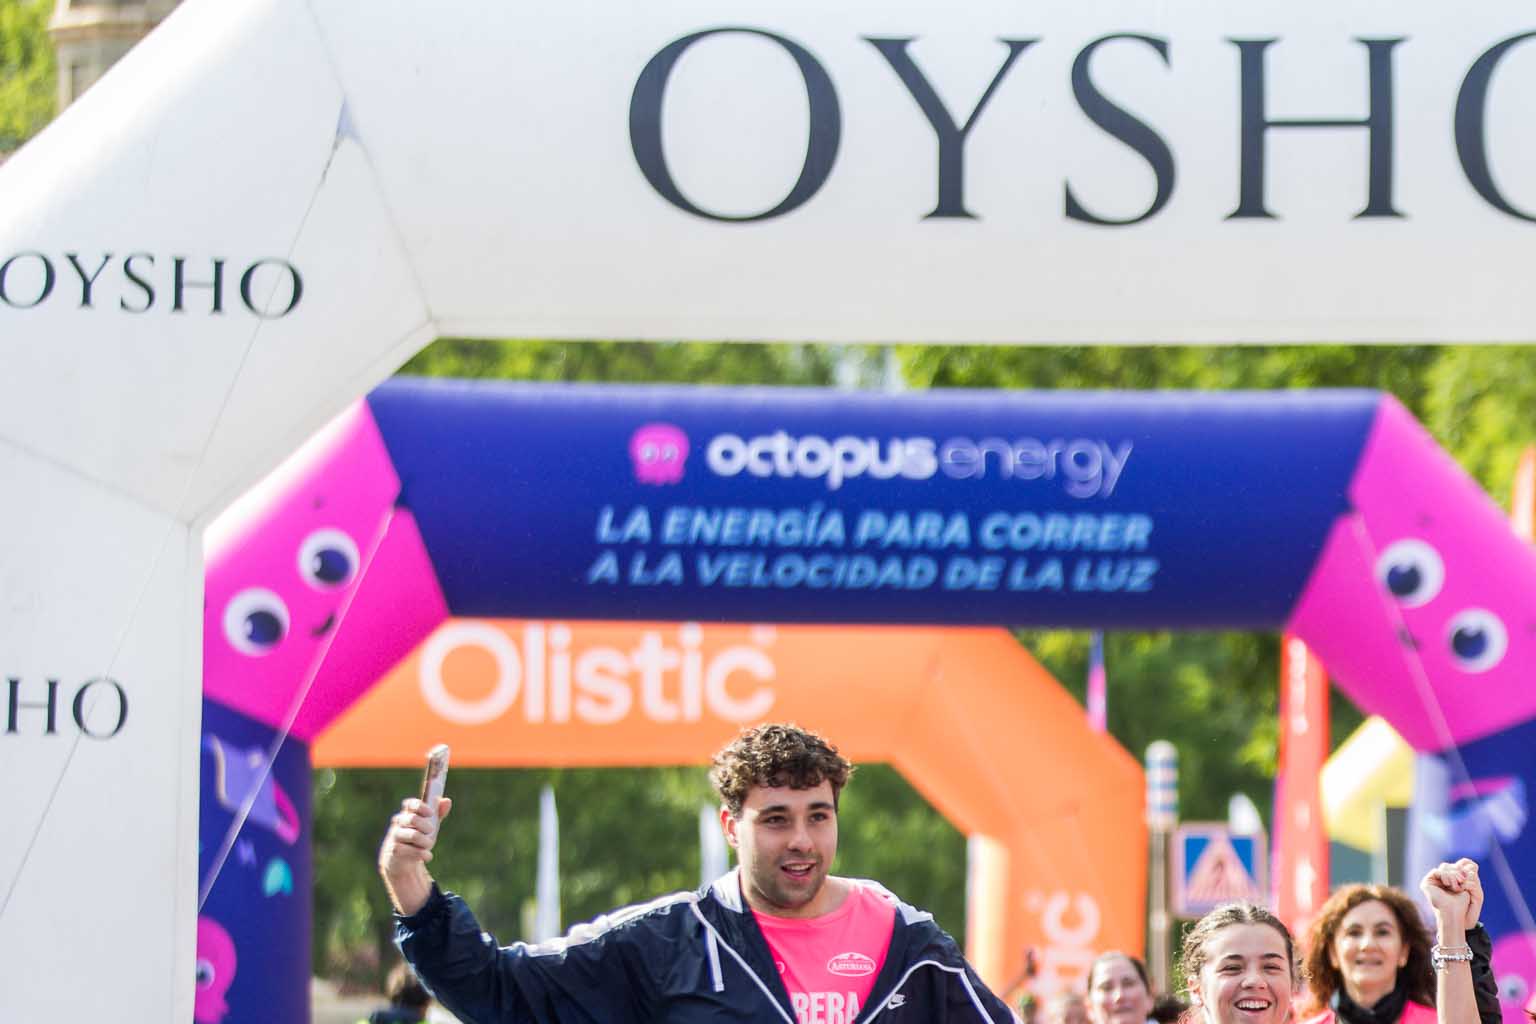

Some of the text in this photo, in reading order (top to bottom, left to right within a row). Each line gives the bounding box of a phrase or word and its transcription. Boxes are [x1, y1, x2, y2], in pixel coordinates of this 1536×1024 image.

[0, 251, 304, 320] OYSHO
[706, 431, 1134, 498] octopus energy
[597, 501, 1154, 551] LA ENERGÍA PARA CORRER
[588, 552, 1160, 593] A LA VELOCIDAD DE LA LUZ
[417, 620, 778, 725] Olistic
